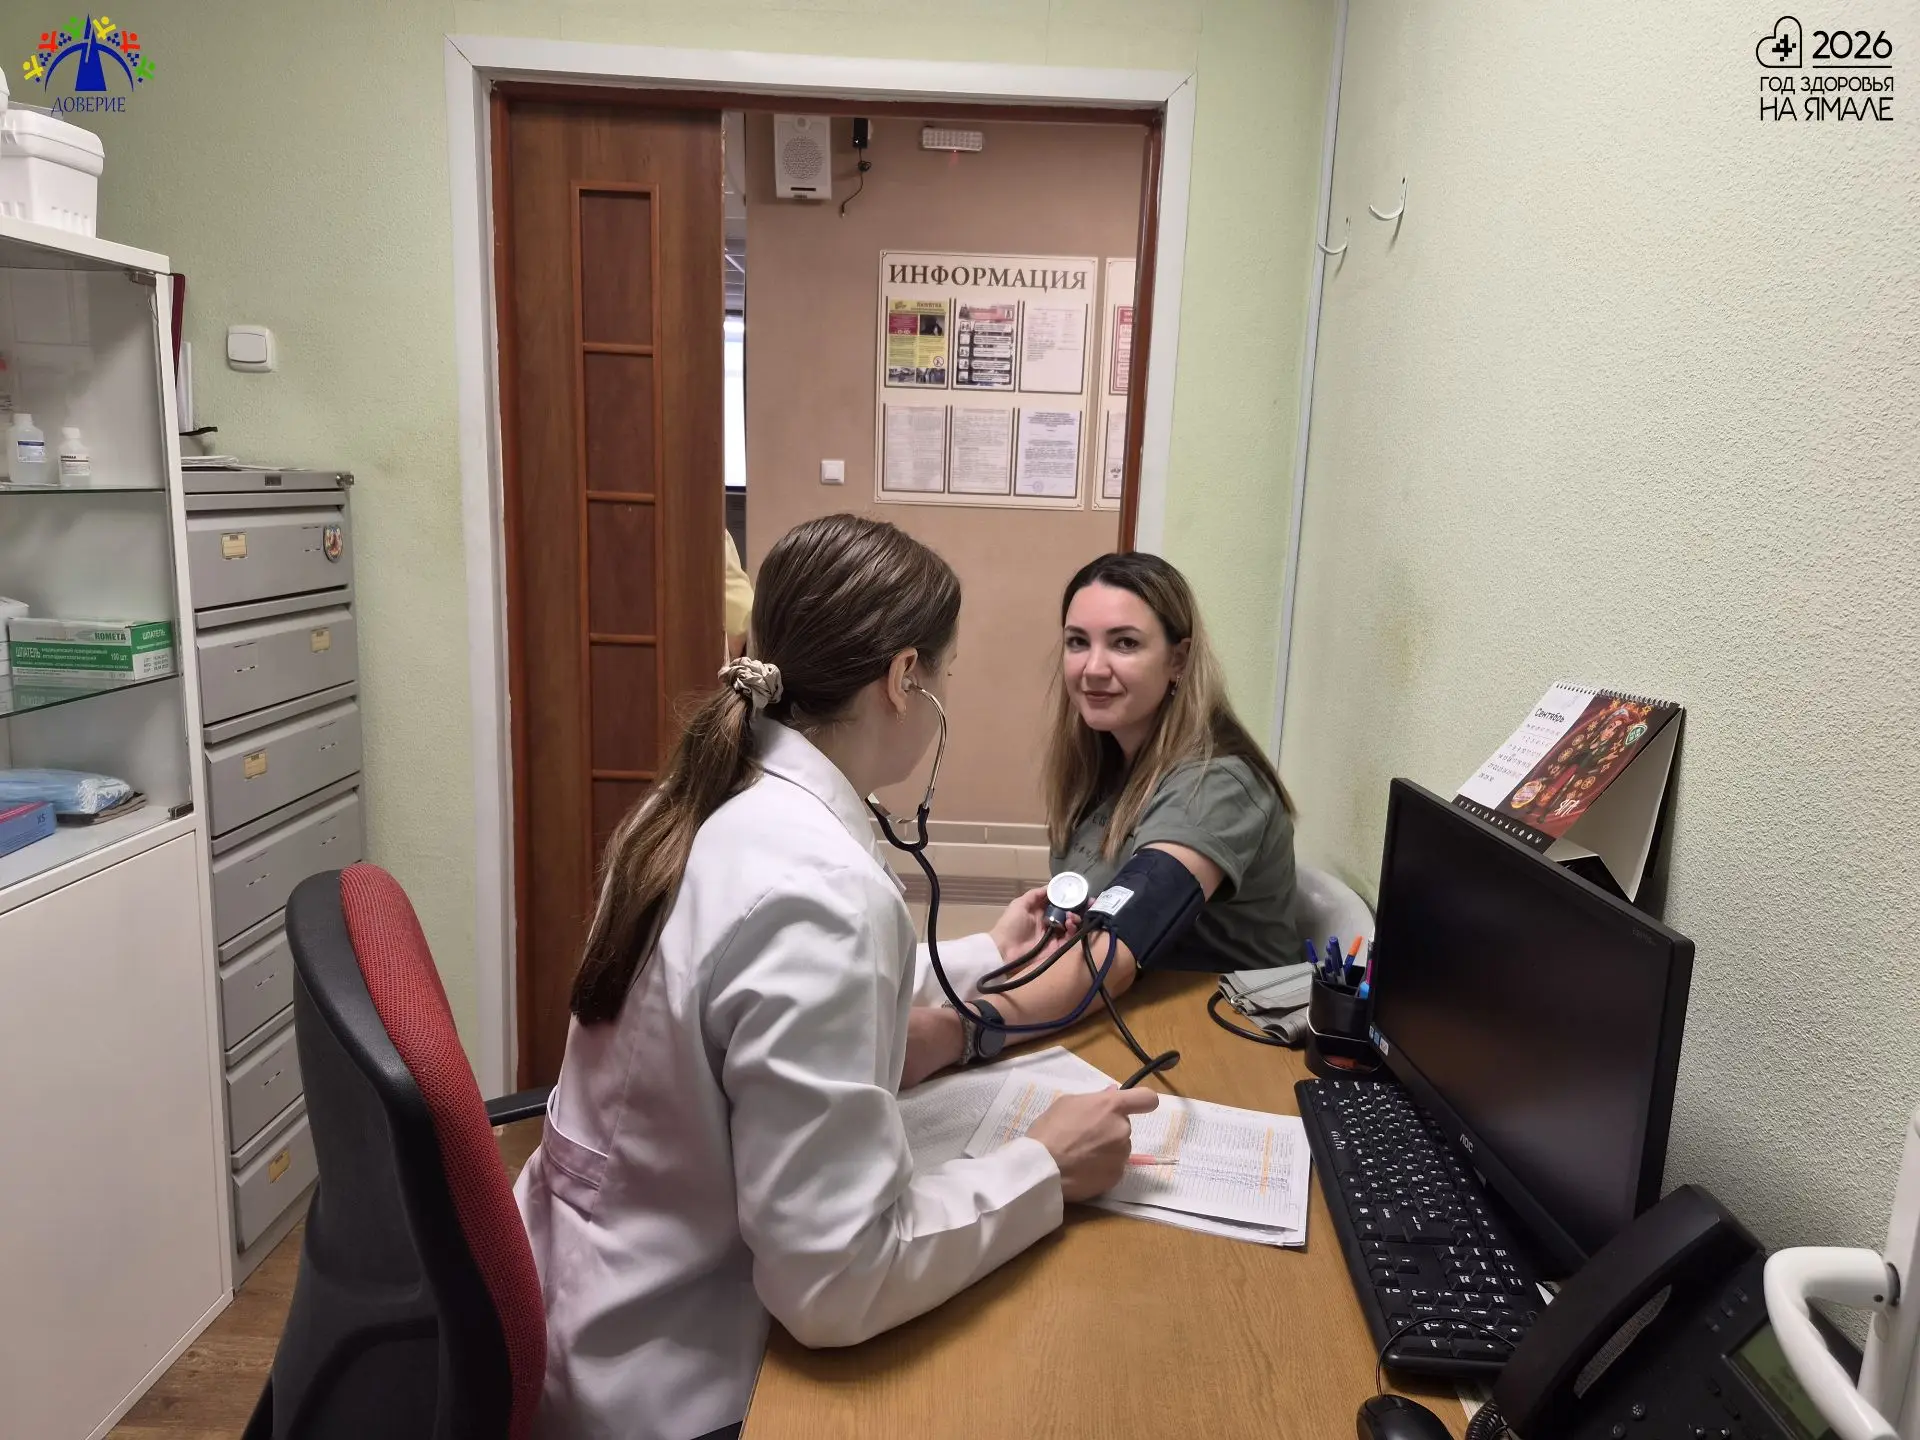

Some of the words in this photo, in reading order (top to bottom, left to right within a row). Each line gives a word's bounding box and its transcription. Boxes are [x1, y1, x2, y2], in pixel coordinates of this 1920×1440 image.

[888, 264, 1088, 293] ИНФОРМАЦИЯ
[15, 646, 41, 659] ШПАТЕЛЬ
[1534, 707, 1565, 723] Сентябрь
